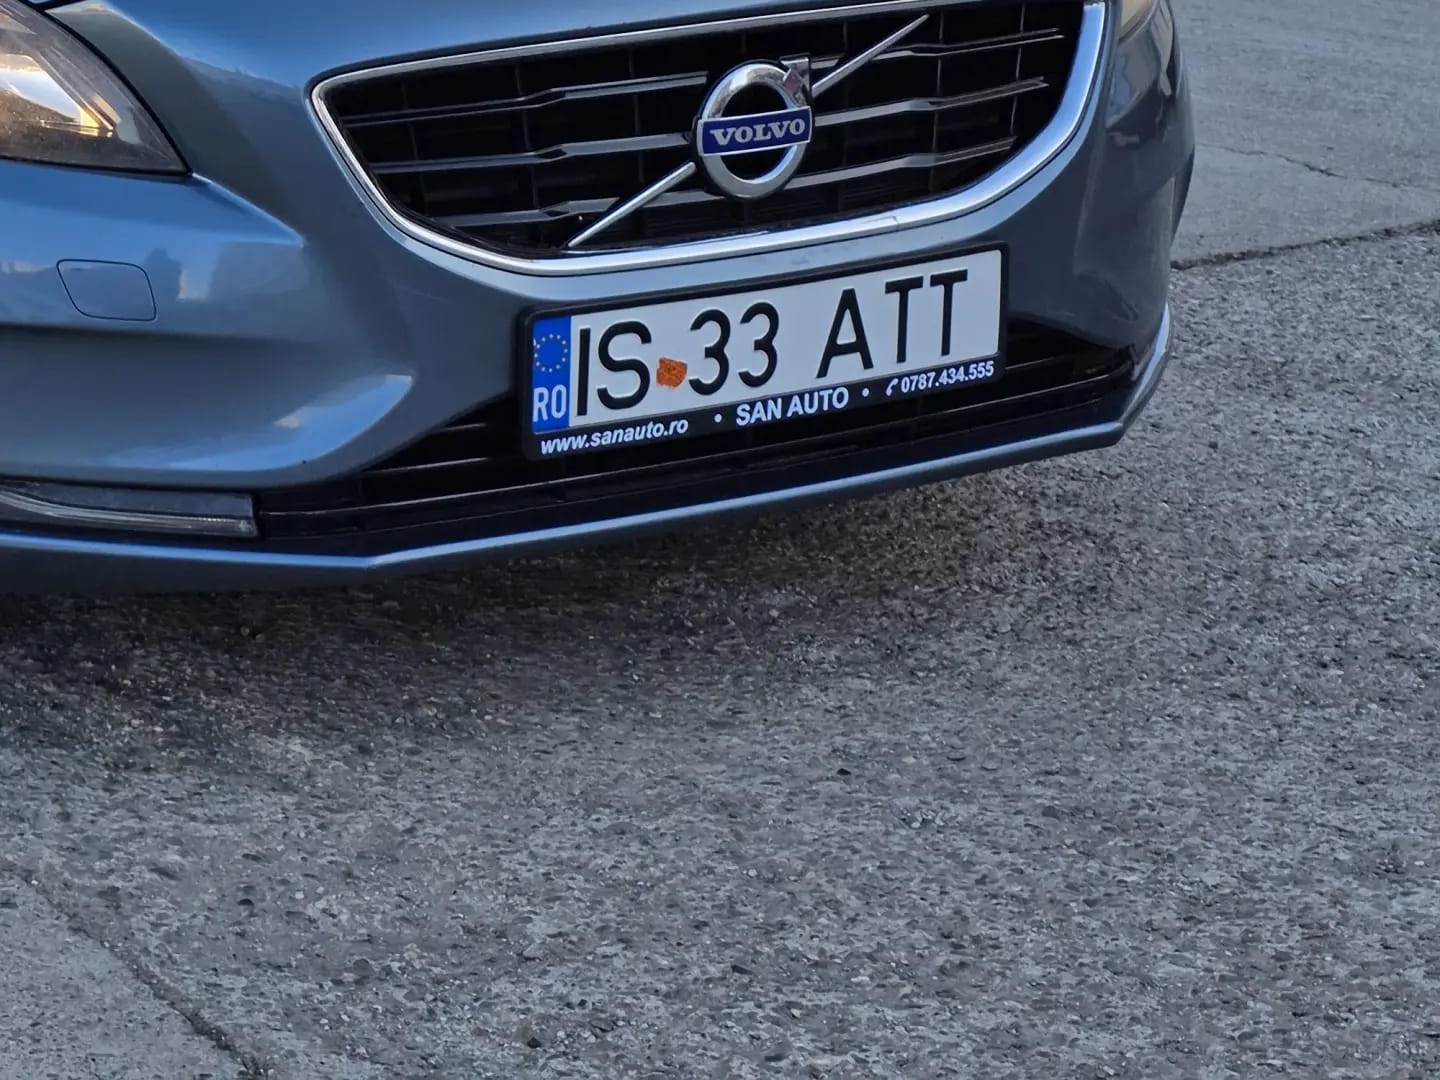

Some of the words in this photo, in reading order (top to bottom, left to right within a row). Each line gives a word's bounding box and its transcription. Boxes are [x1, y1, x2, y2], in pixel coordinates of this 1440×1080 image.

[710, 118, 806, 146] VOLVO
[576, 321, 652, 417] IS
[688, 302, 780, 396] 33
[816, 270, 968, 380] ATT
[532, 384, 567, 422] RO
[540, 419, 689, 454] www.sanauto.ro
[735, 398, 783, 426] SAN
[786, 387, 849, 419] AUTO
[900, 361, 995, 393] 0787.434.555
